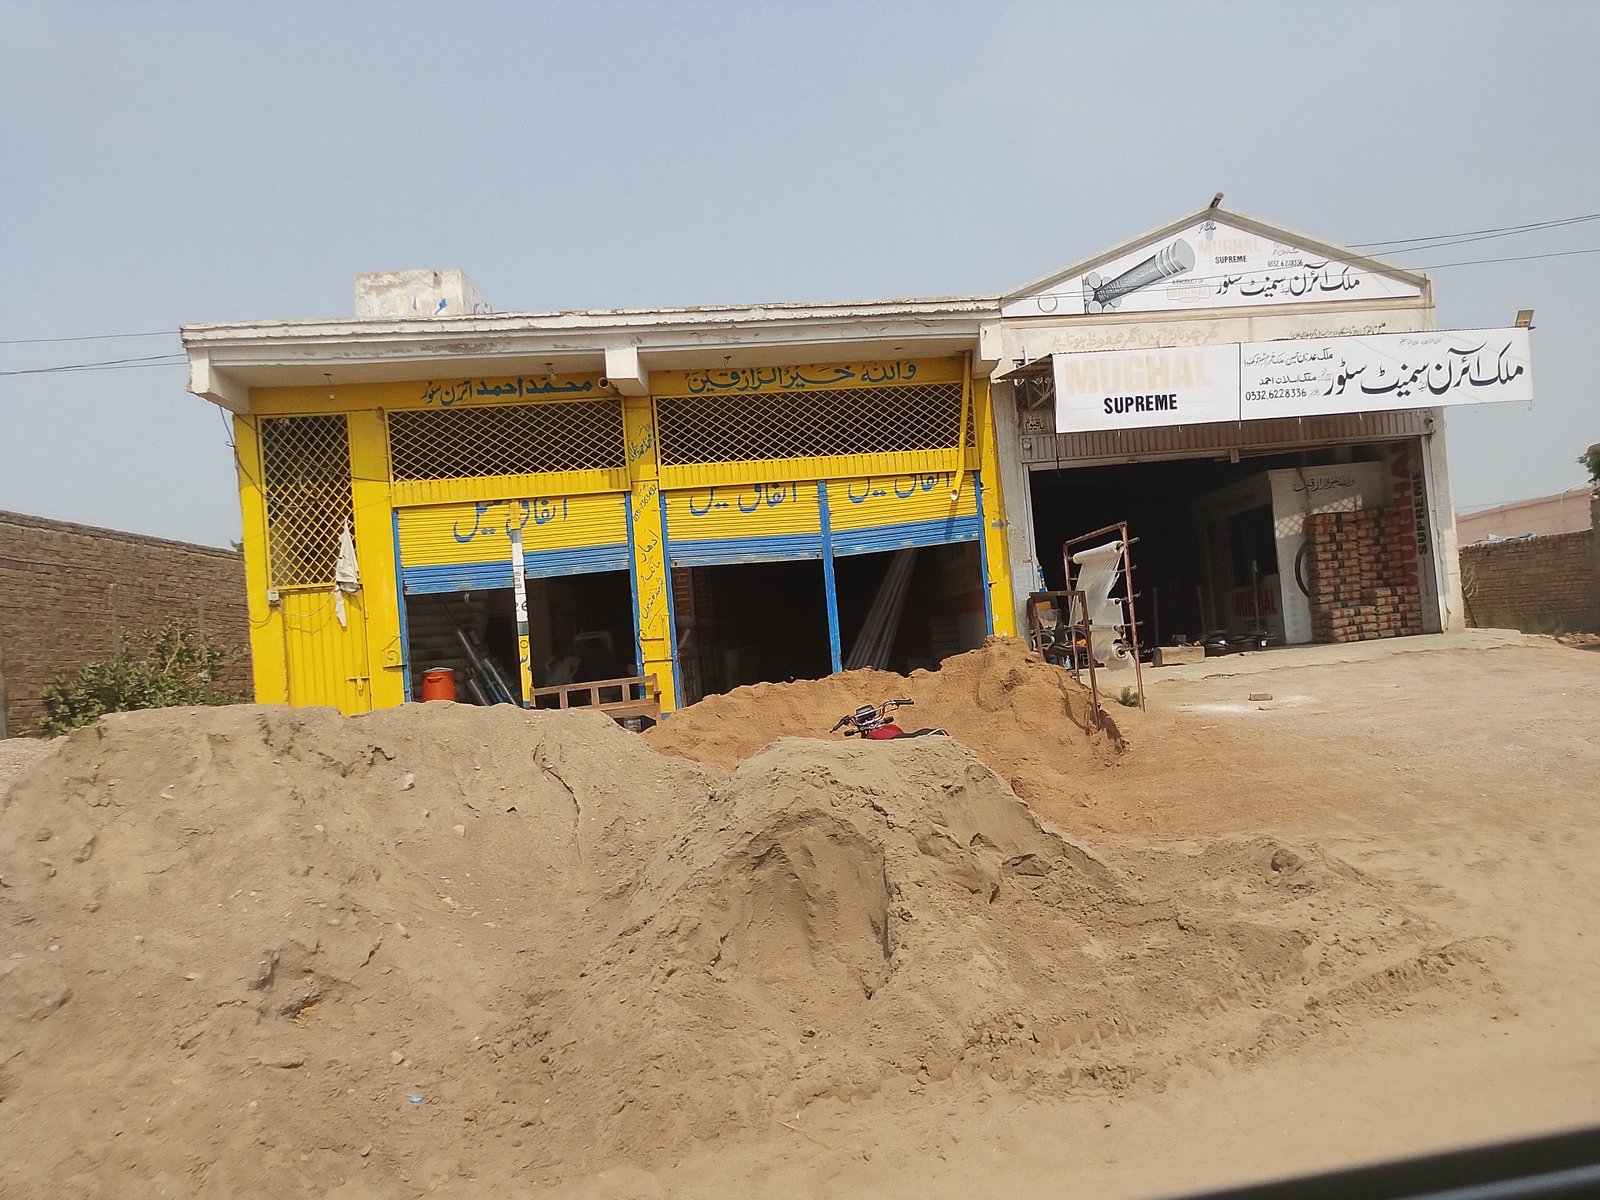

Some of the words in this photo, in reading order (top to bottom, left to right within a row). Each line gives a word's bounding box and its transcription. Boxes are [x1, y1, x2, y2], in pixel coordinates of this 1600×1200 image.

[1215, 255, 1247, 264] SUPREME
[1319, 266, 1360, 291] ملک
[1318, 347, 1333, 360] ملک
[1467, 341, 1524, 387] ملک
[1065, 354, 1215, 394] MUGHAL
[1259, 376, 1275, 386] احمد
[1323, 361, 1368, 396] سٹور
[477, 378, 523, 398] احمد
[1245, 388, 1307, 401] 0332.6228336
[1104, 393, 1178, 415] SUPREME
[1412, 470, 1428, 556] SUPREME
